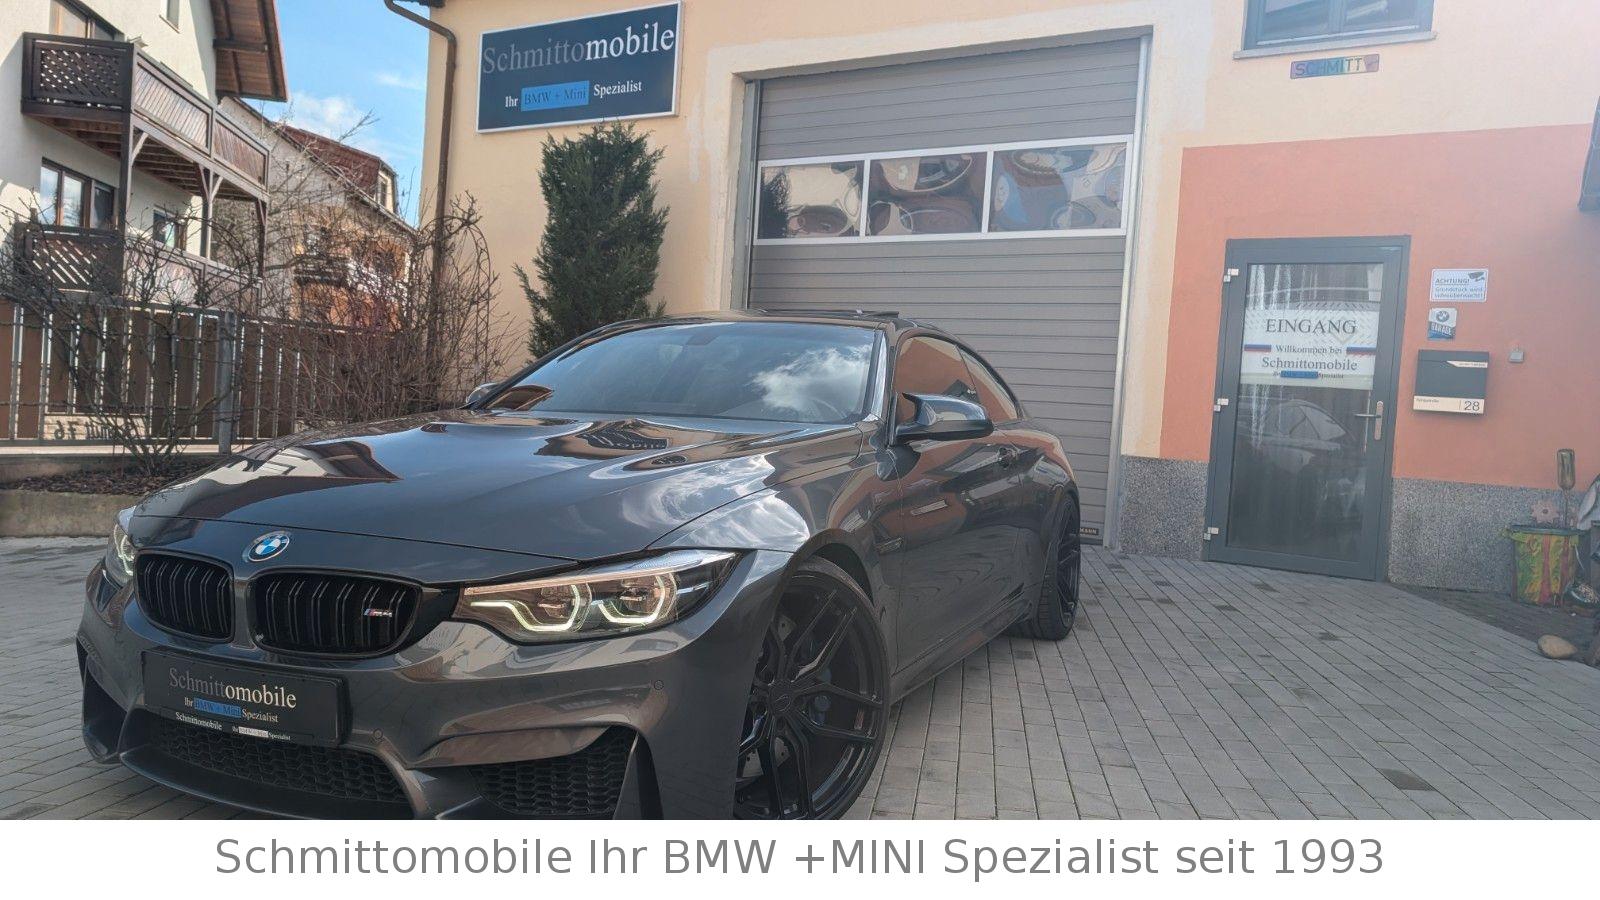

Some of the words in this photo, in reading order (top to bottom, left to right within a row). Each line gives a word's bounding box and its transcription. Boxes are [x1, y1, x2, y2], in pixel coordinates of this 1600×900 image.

[482, 21, 675, 74] Schmittomobile
[1295, 57, 1362, 76] SCHMITT
[505, 95, 520, 108] Ihr
[524, 90, 552, 105] BMW
[564, 86, 587, 100] Mini
[593, 80, 642, 98] Spezialist
[1266, 318, 1357, 334] EINGANG
[1275, 344, 1328, 355] Willkommen
[1329, 345, 1342, 354] bei
[1262, 356, 1358, 370] Schmittomobile
[1464, 401, 1480, 411] 28
[169, 667, 297, 708] Schmittomobile
[184, 697, 193, 707] Ihr
[242, 708, 278, 723] Spezialist
